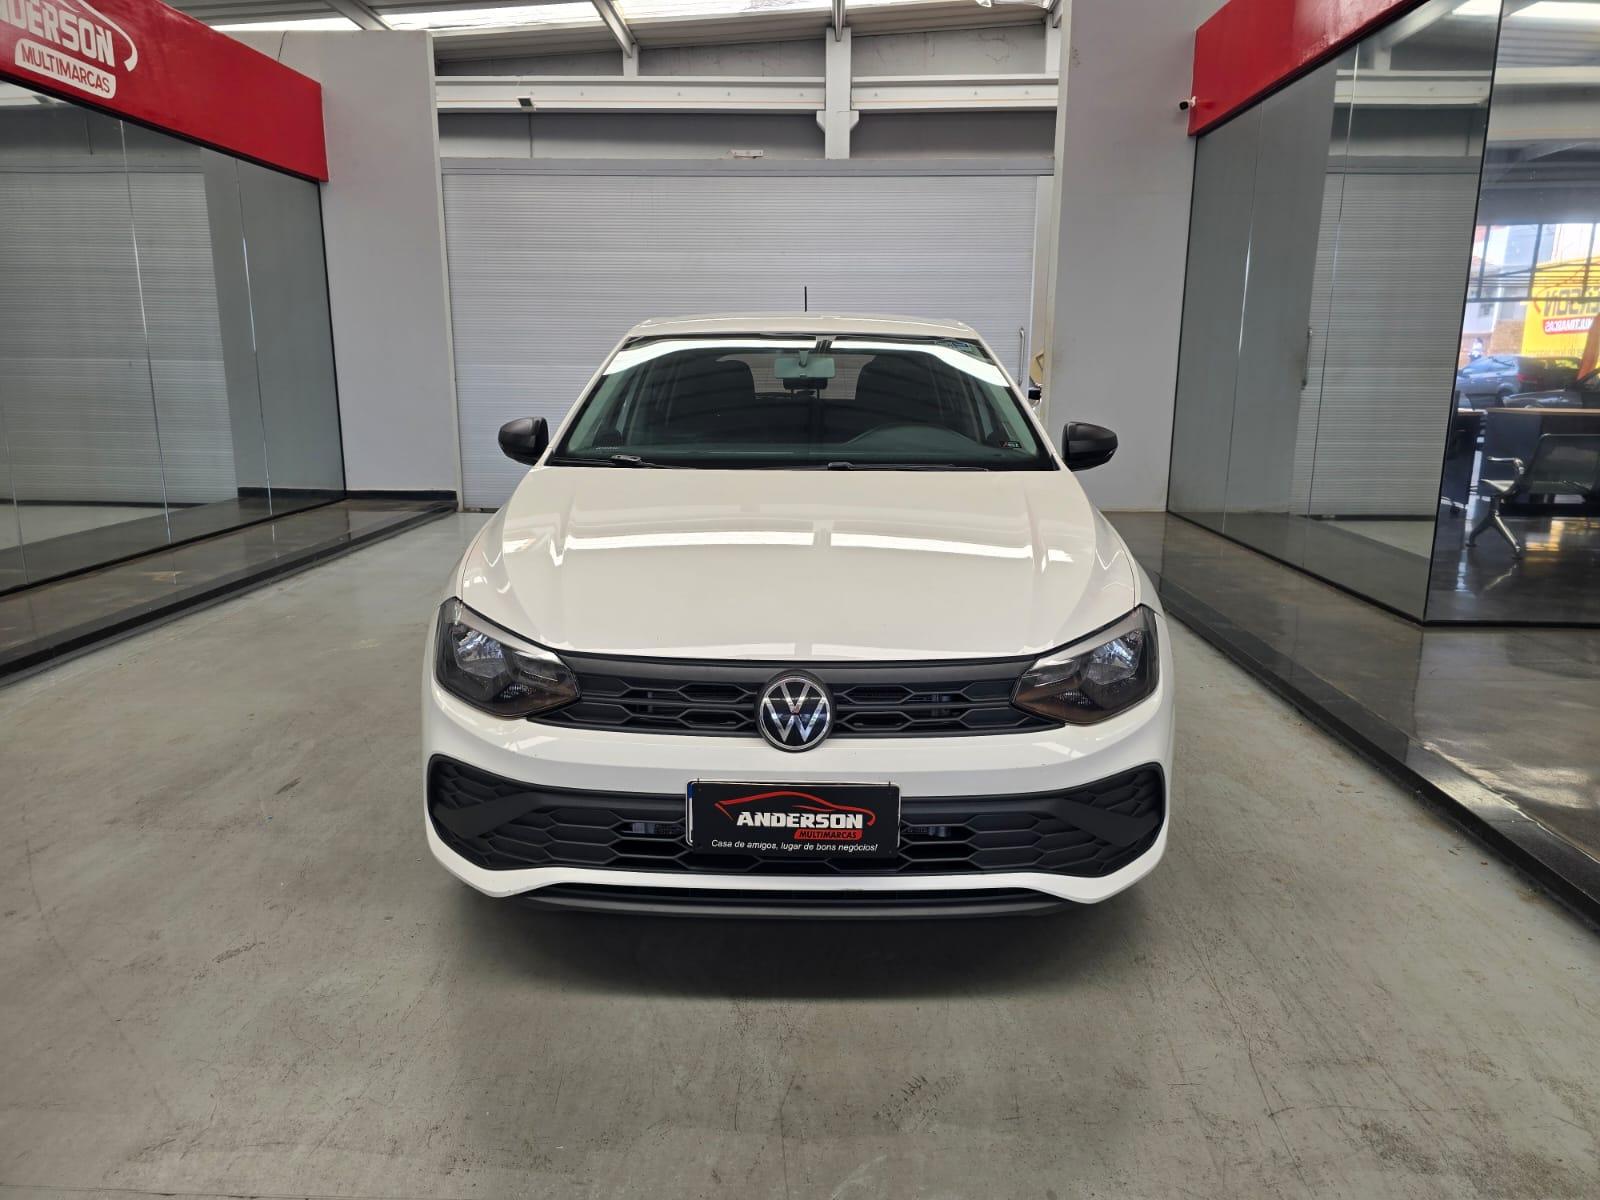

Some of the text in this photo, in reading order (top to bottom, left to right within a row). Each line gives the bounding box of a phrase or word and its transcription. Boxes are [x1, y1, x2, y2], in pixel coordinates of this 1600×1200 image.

[20, 42, 111, 94] MULTIMARCAS
[736, 811, 863, 829] ANDERSON
[799, 830, 857, 839] MULTIMARCAS
[711, 839, 879, 853] Casa de amigos, lugar de bons negócios!
